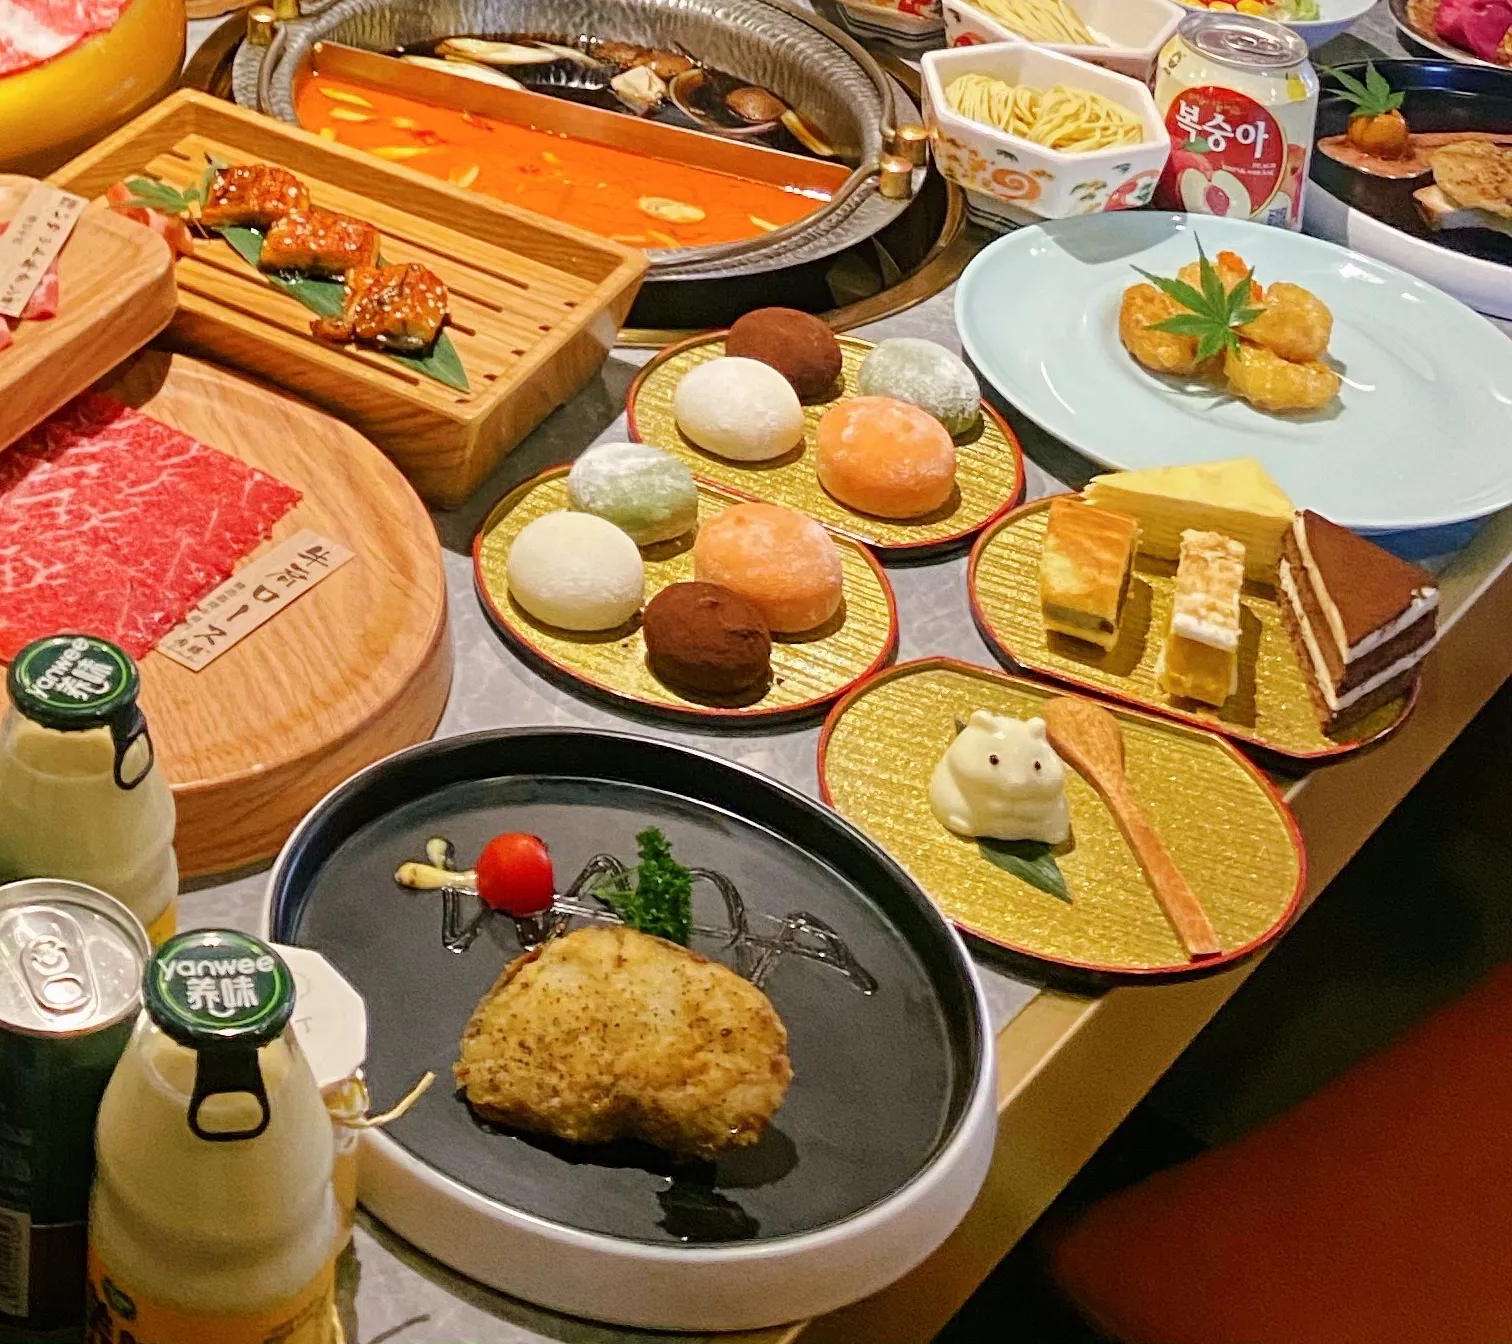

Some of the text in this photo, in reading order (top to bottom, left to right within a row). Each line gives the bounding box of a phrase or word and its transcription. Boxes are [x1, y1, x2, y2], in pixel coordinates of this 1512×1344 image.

[1175, 99, 1269, 159] 복숭아
[25, 637, 89, 698] yanwee
[54, 658, 113, 701] 养味
[158, 955, 274, 981] yanwee
[185, 975, 259, 1018] 养味
